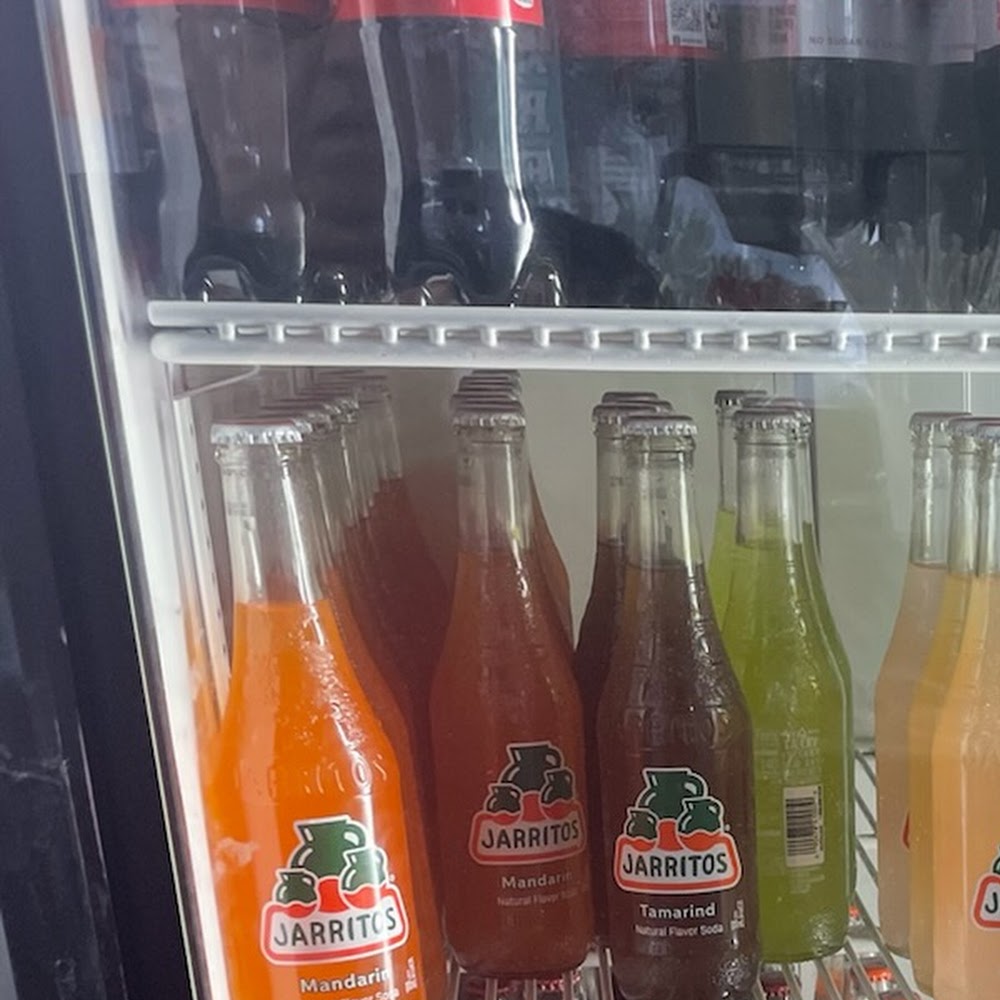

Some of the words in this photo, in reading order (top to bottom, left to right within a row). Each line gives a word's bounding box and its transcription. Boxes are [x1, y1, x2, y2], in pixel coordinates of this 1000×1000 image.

[482, 819, 579, 849] JARRITOS
[622, 852, 728, 878] JARRITOS
[639, 901, 716, 919] Tamarind
[273, 907, 397, 948] JARRITOS
[634, 923, 668, 937] Natural
[668, 925, 699, 936] Flavor
[699, 923, 724, 936] Soda
